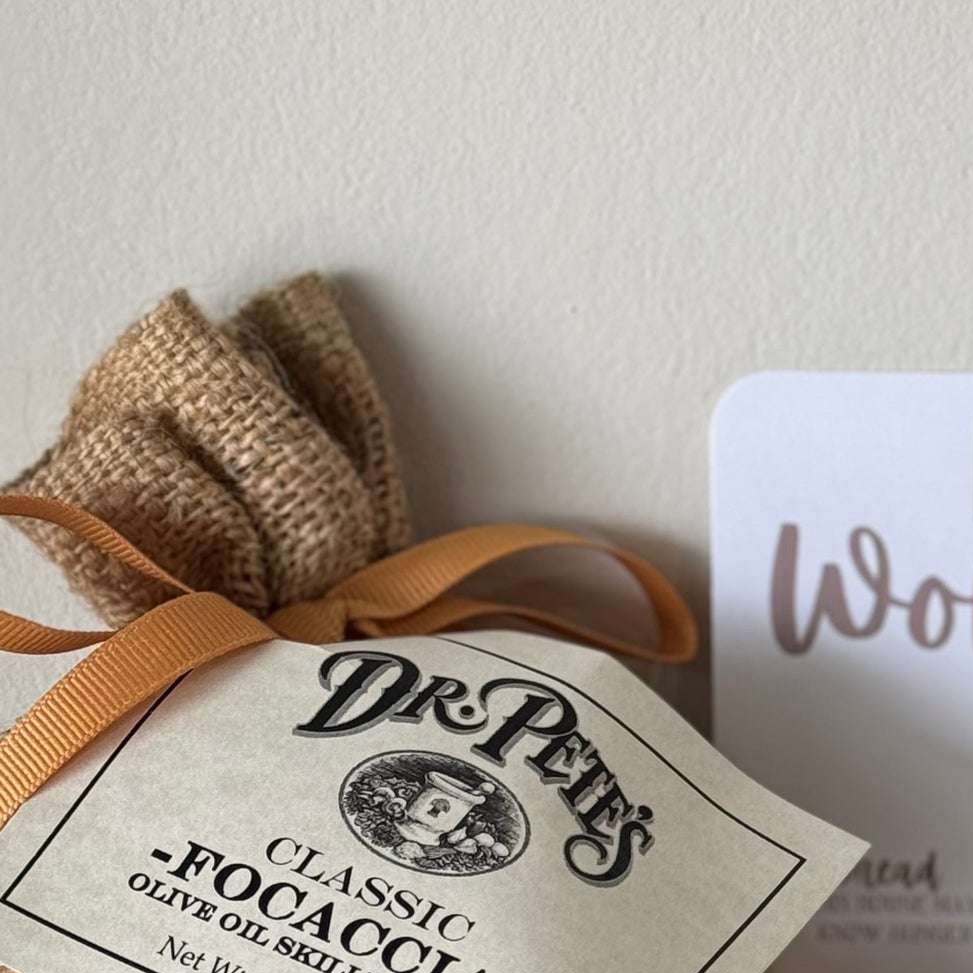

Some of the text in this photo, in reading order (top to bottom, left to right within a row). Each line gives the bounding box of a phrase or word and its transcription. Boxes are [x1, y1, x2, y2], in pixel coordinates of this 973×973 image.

[128, 872, 218, 921] OLIVE
[220, 910, 270, 946] OIL
[265, 836, 476, 944] CLASSIC
